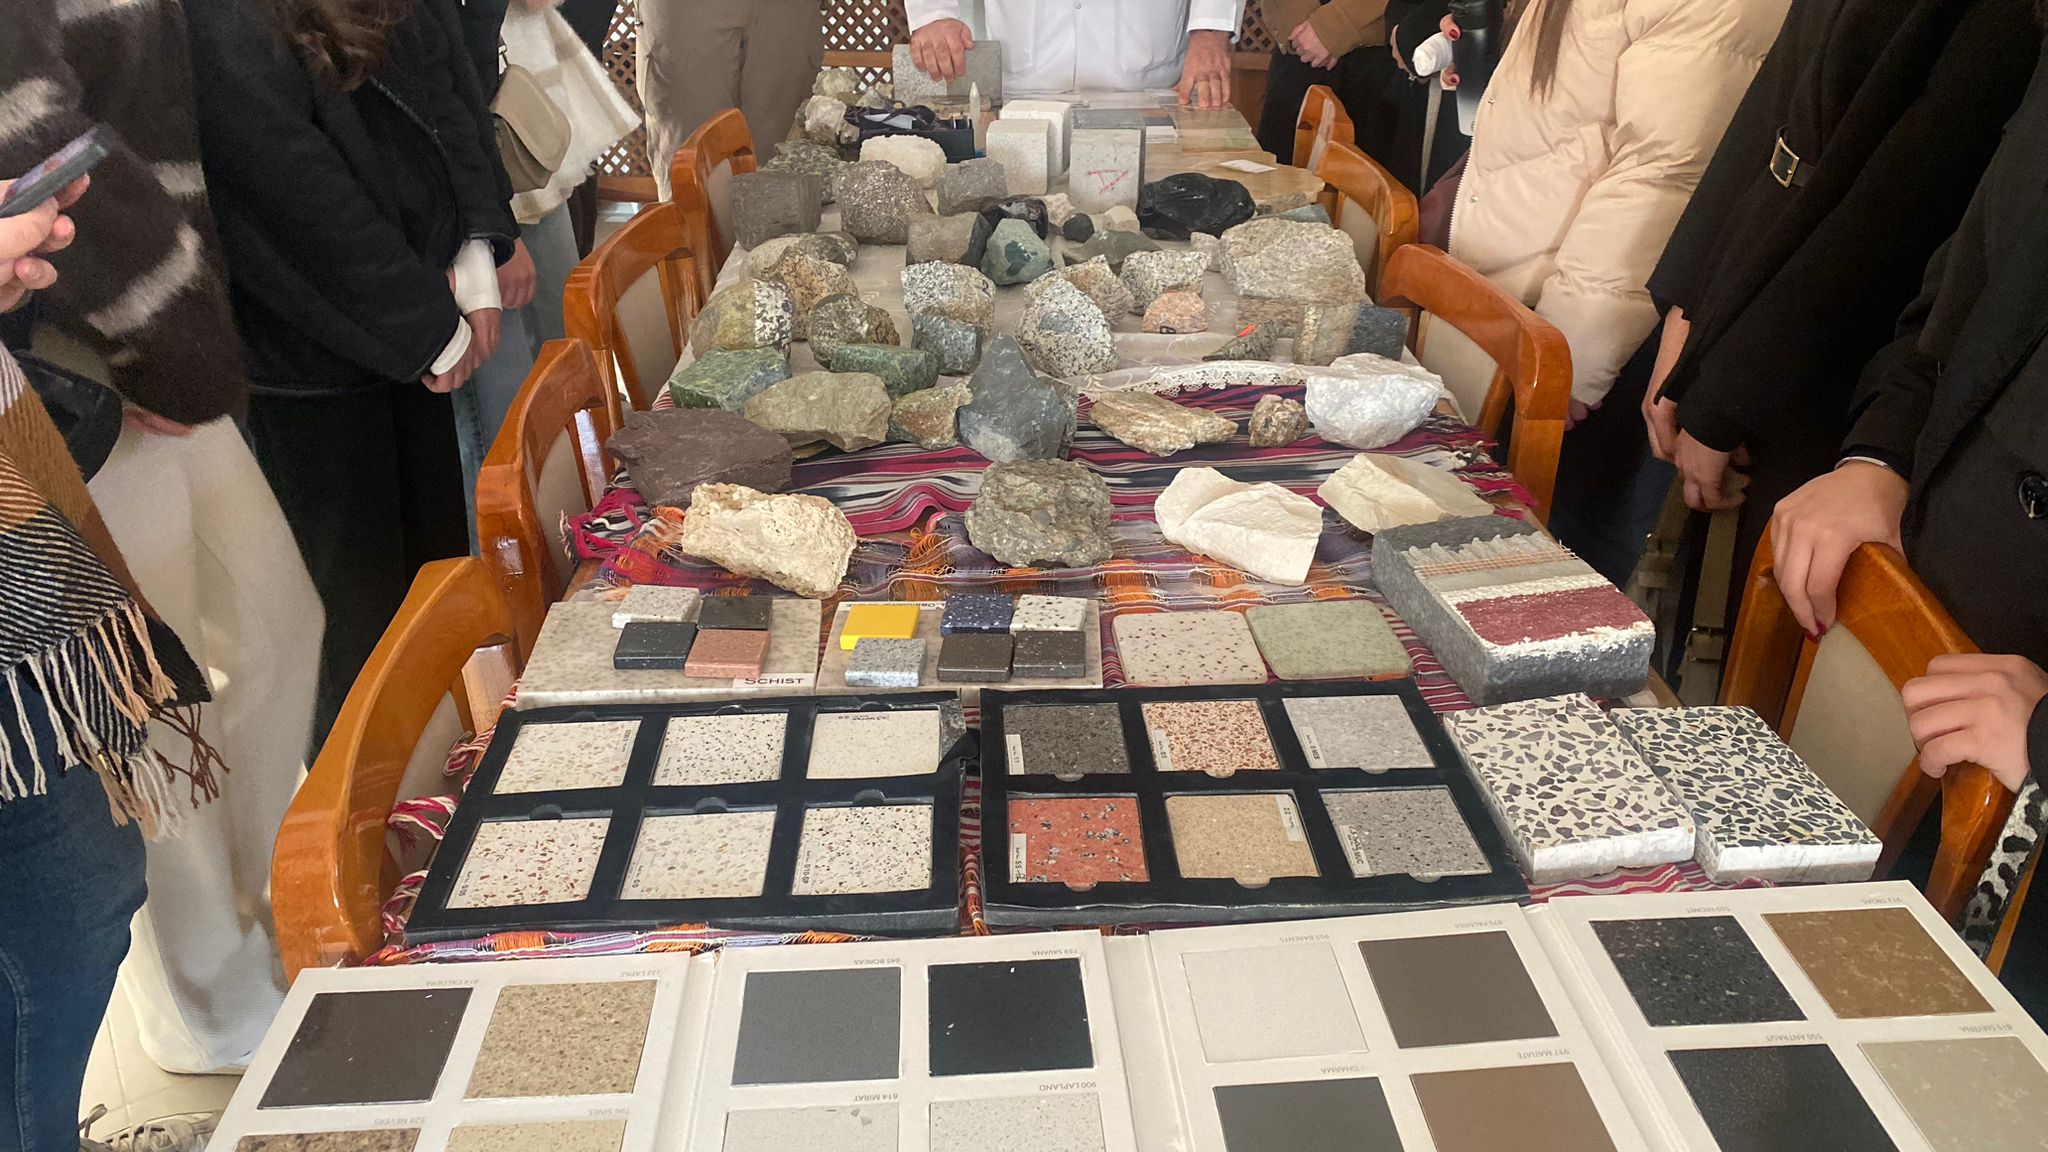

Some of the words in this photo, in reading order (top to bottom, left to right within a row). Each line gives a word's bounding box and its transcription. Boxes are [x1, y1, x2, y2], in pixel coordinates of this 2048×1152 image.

[744, 677, 805, 685] SCHIST
[1038, 1082, 1080, 1092] LAPLAND
[1081, 1081, 1097, 1089] 900
[853, 1094, 881, 1102] MIRAT
[882, 1093, 899, 1101] 614
